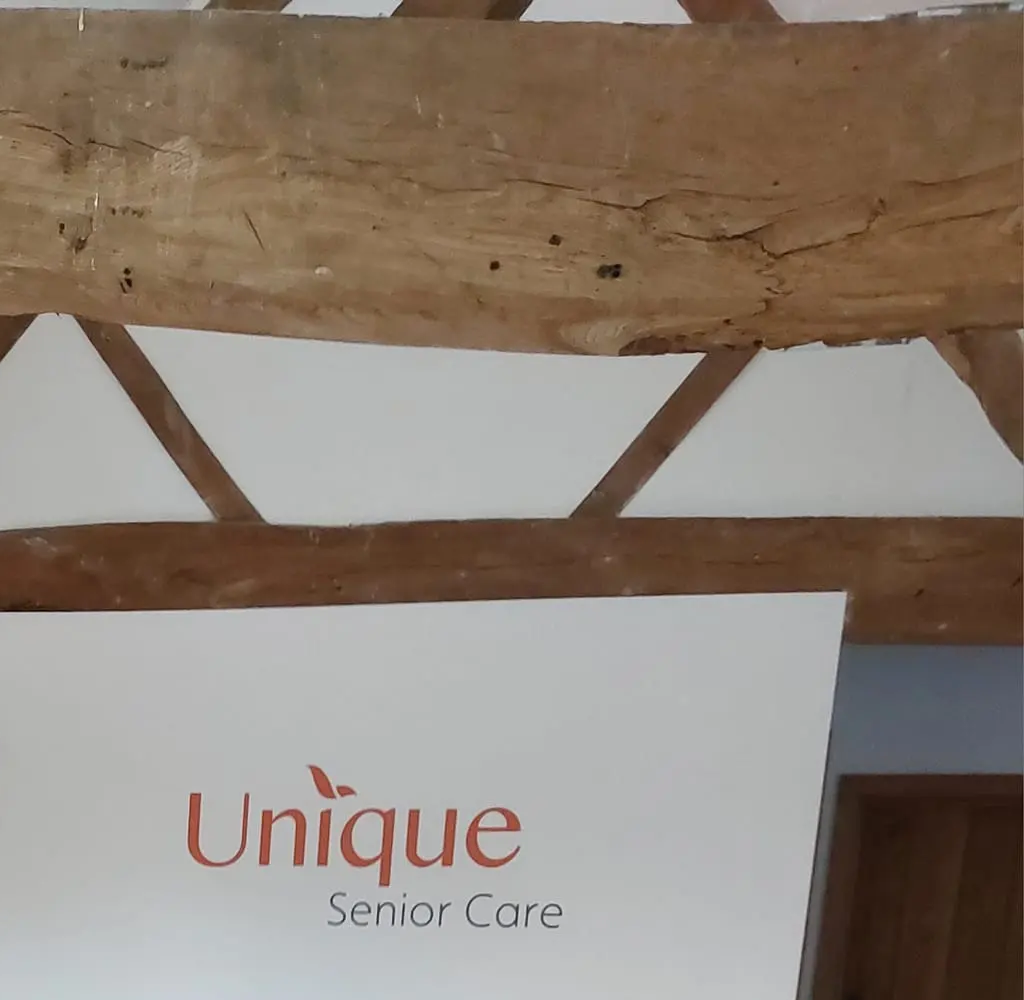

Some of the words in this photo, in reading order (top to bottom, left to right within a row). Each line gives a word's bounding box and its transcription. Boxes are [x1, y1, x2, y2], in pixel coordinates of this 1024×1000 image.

[187, 764, 521, 887] Unique
[327, 891, 451, 928] Senior
[465, 893, 563, 929] Care
